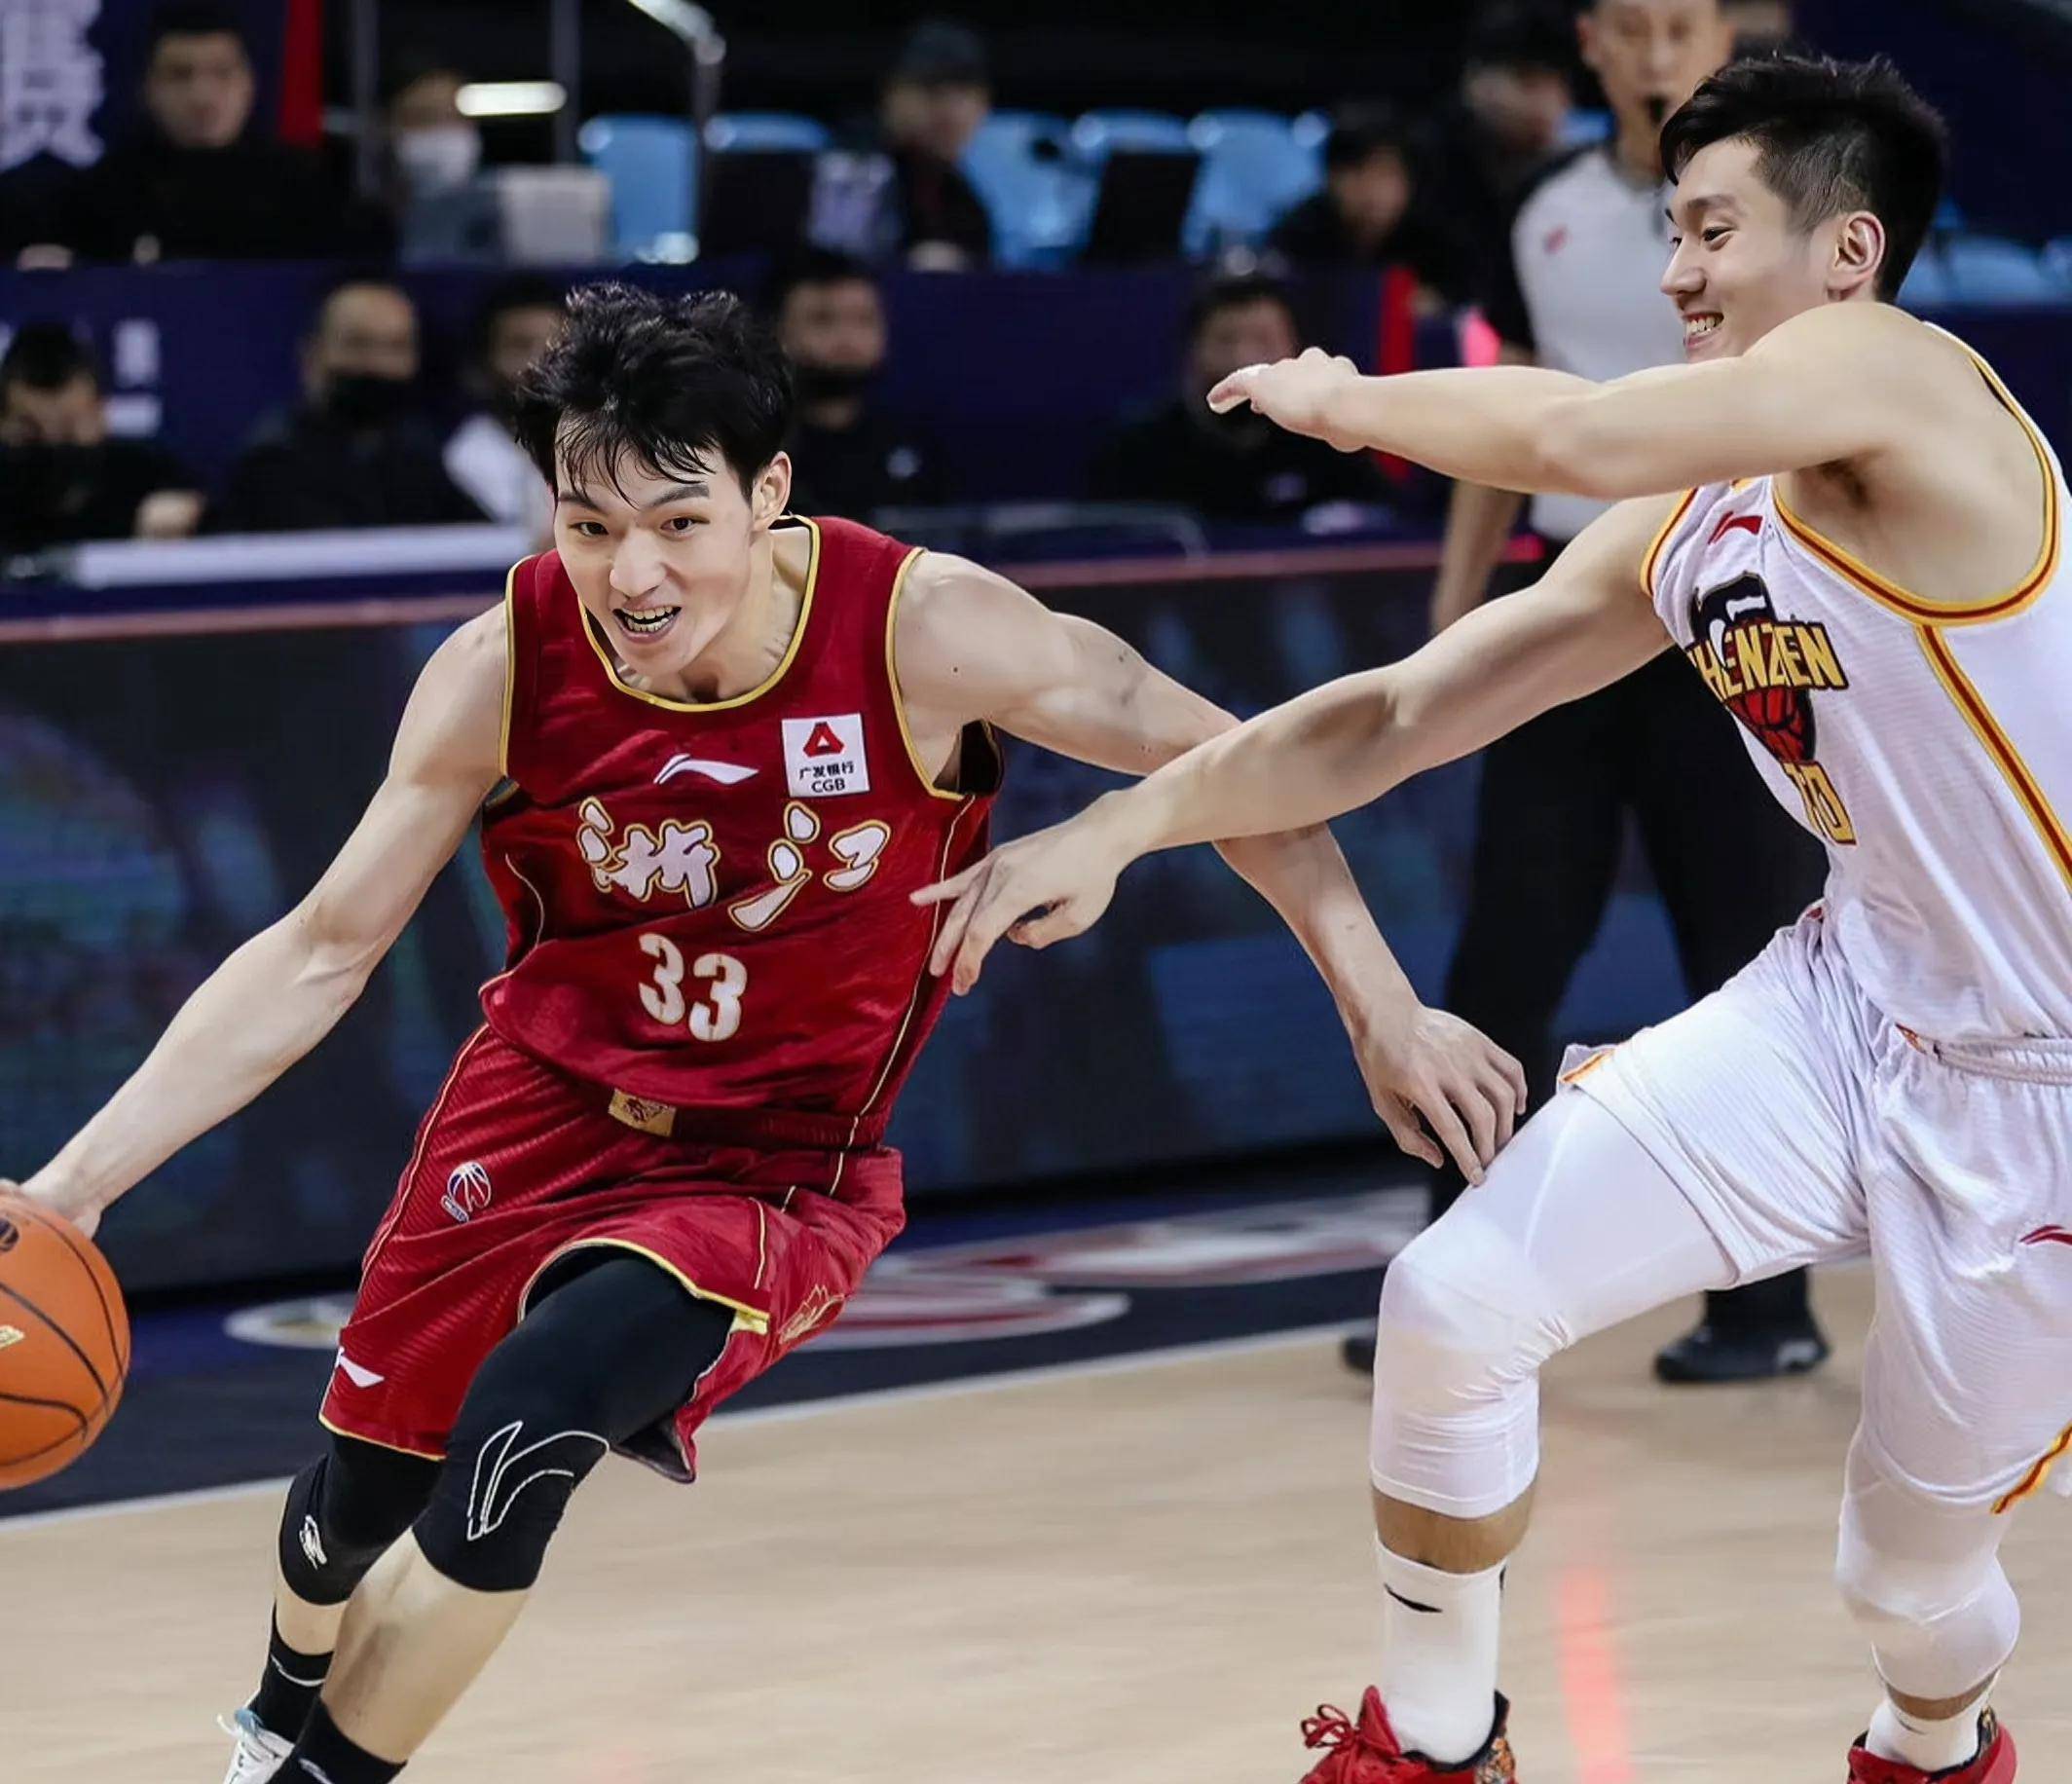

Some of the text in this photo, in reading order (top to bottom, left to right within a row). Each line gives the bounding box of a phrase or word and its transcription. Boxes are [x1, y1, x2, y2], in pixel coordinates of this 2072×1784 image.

[799, 761, 854, 780] 广发银行
[811, 778, 845, 793] CGB
[576, 796, 891, 933] 浙江
[639, 932, 748, 1042] 33
